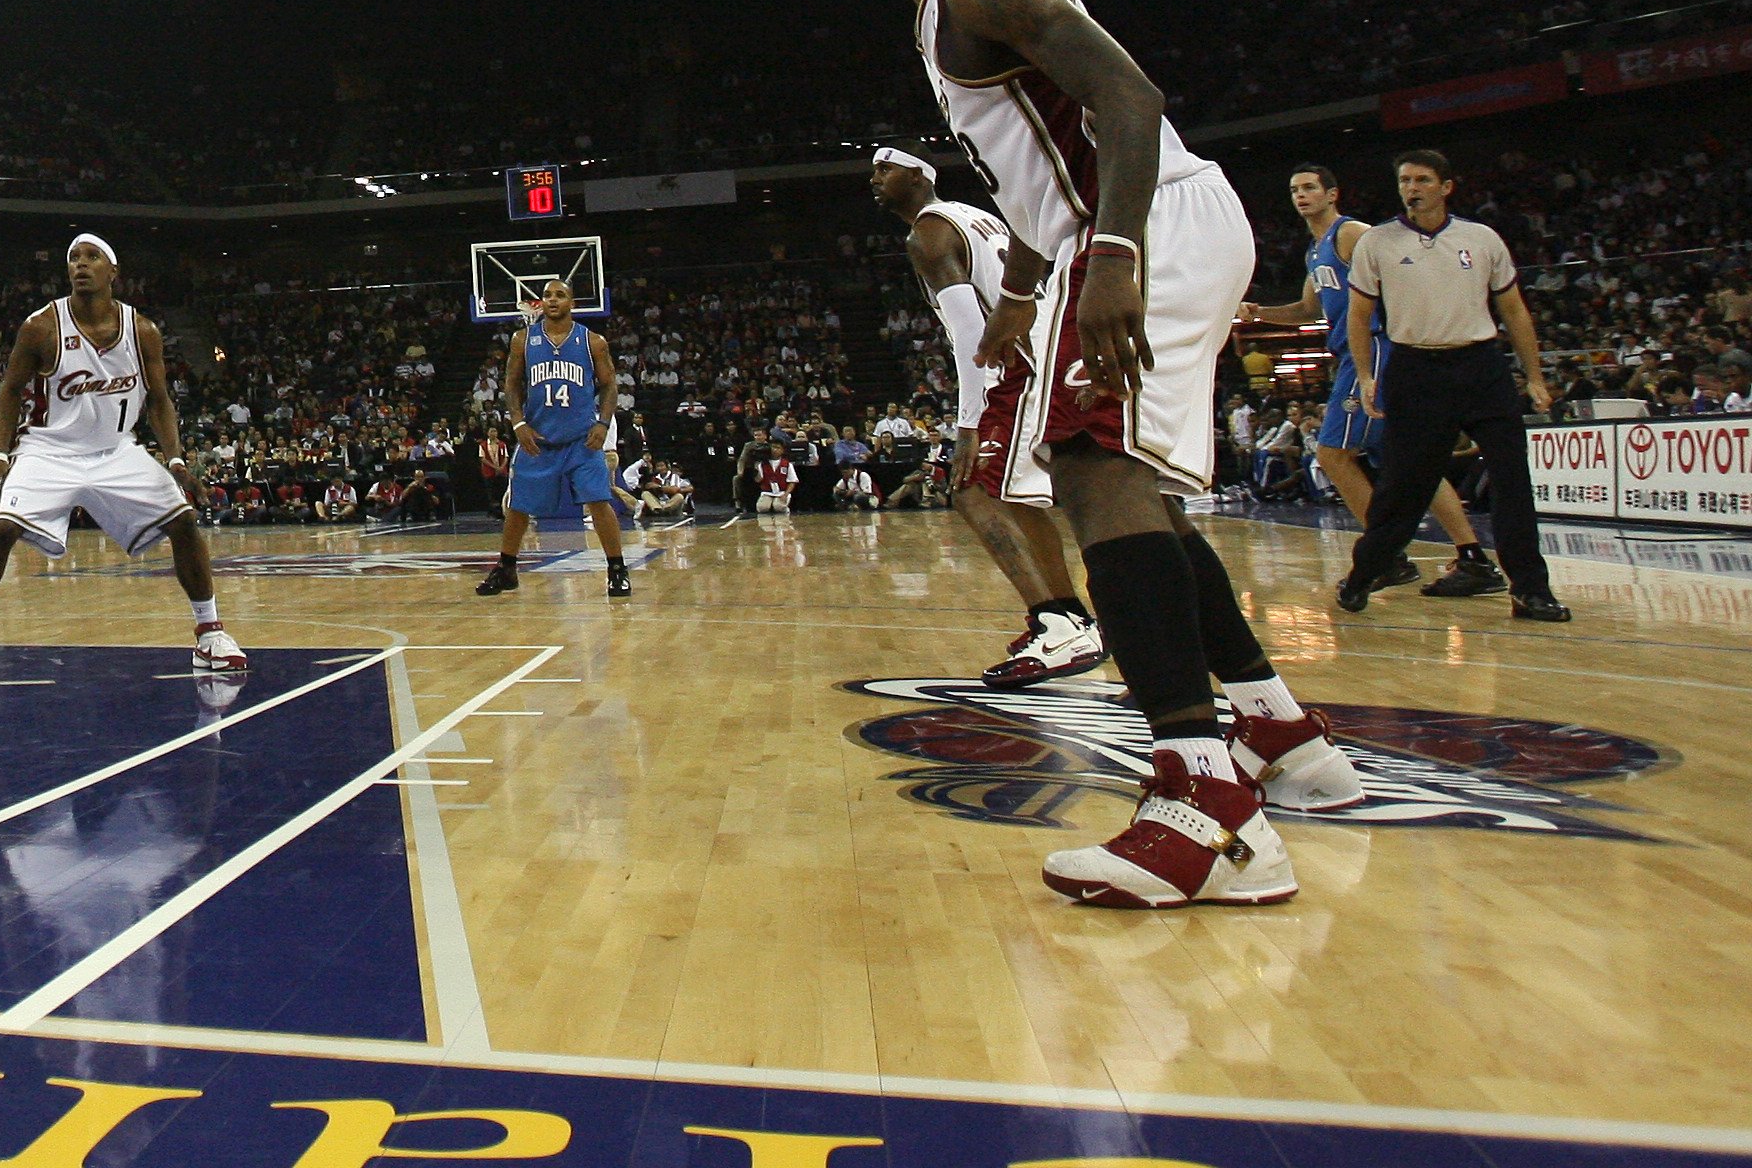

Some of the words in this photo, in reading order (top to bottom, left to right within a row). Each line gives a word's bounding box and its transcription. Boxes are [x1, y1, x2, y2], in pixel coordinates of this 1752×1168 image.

[523, 171, 553, 187] 3:56
[530, 360, 584, 386] ORLANDO
[544, 384, 569, 408] 14
[116, 398, 128, 433] 1
[1531, 431, 1607, 470] TOYOTA
[1662, 427, 1752, 475] TOYOT
